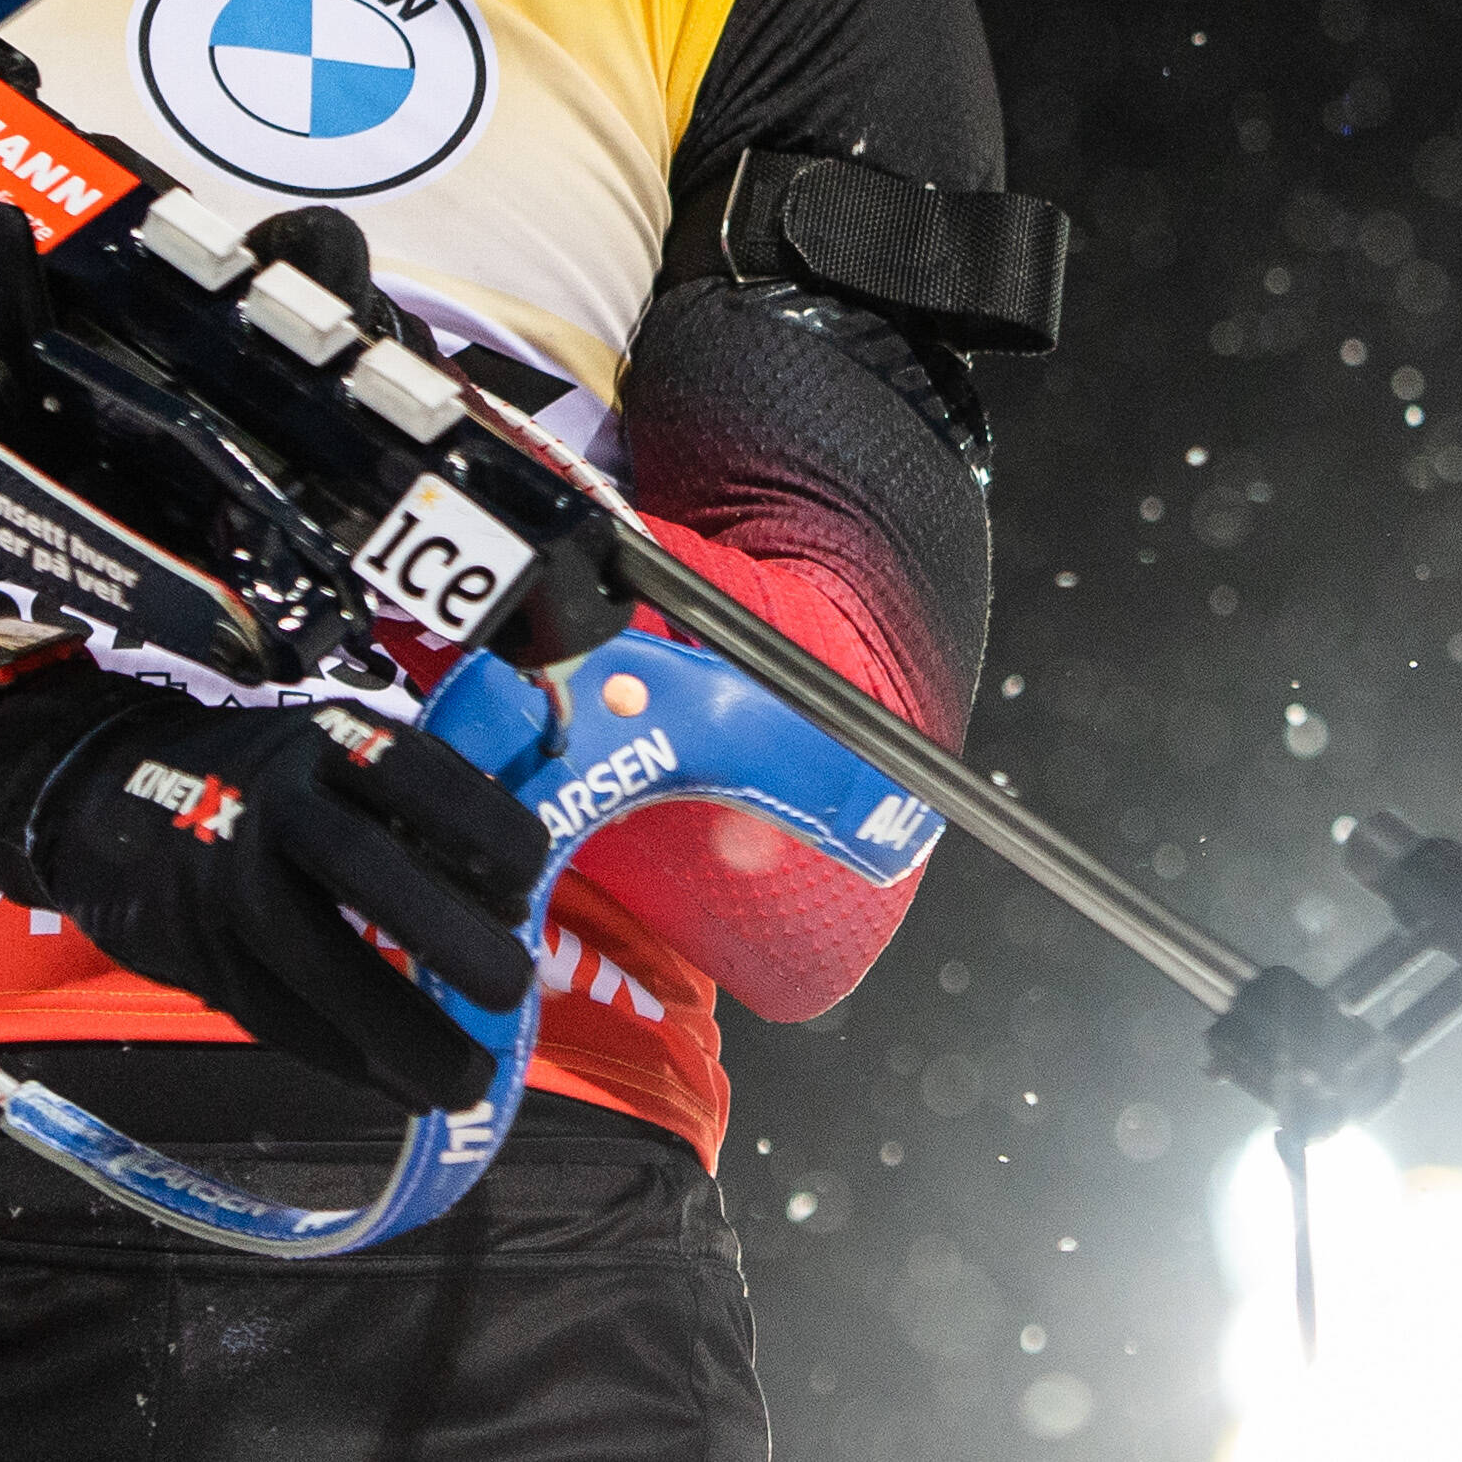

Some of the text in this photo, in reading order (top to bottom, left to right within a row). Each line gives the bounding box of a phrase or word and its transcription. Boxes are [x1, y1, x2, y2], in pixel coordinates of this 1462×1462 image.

[32, 548, 73, 583] på
[69, 535, 140, 588] hvor
[537, 728, 679, 842] ARSEN
